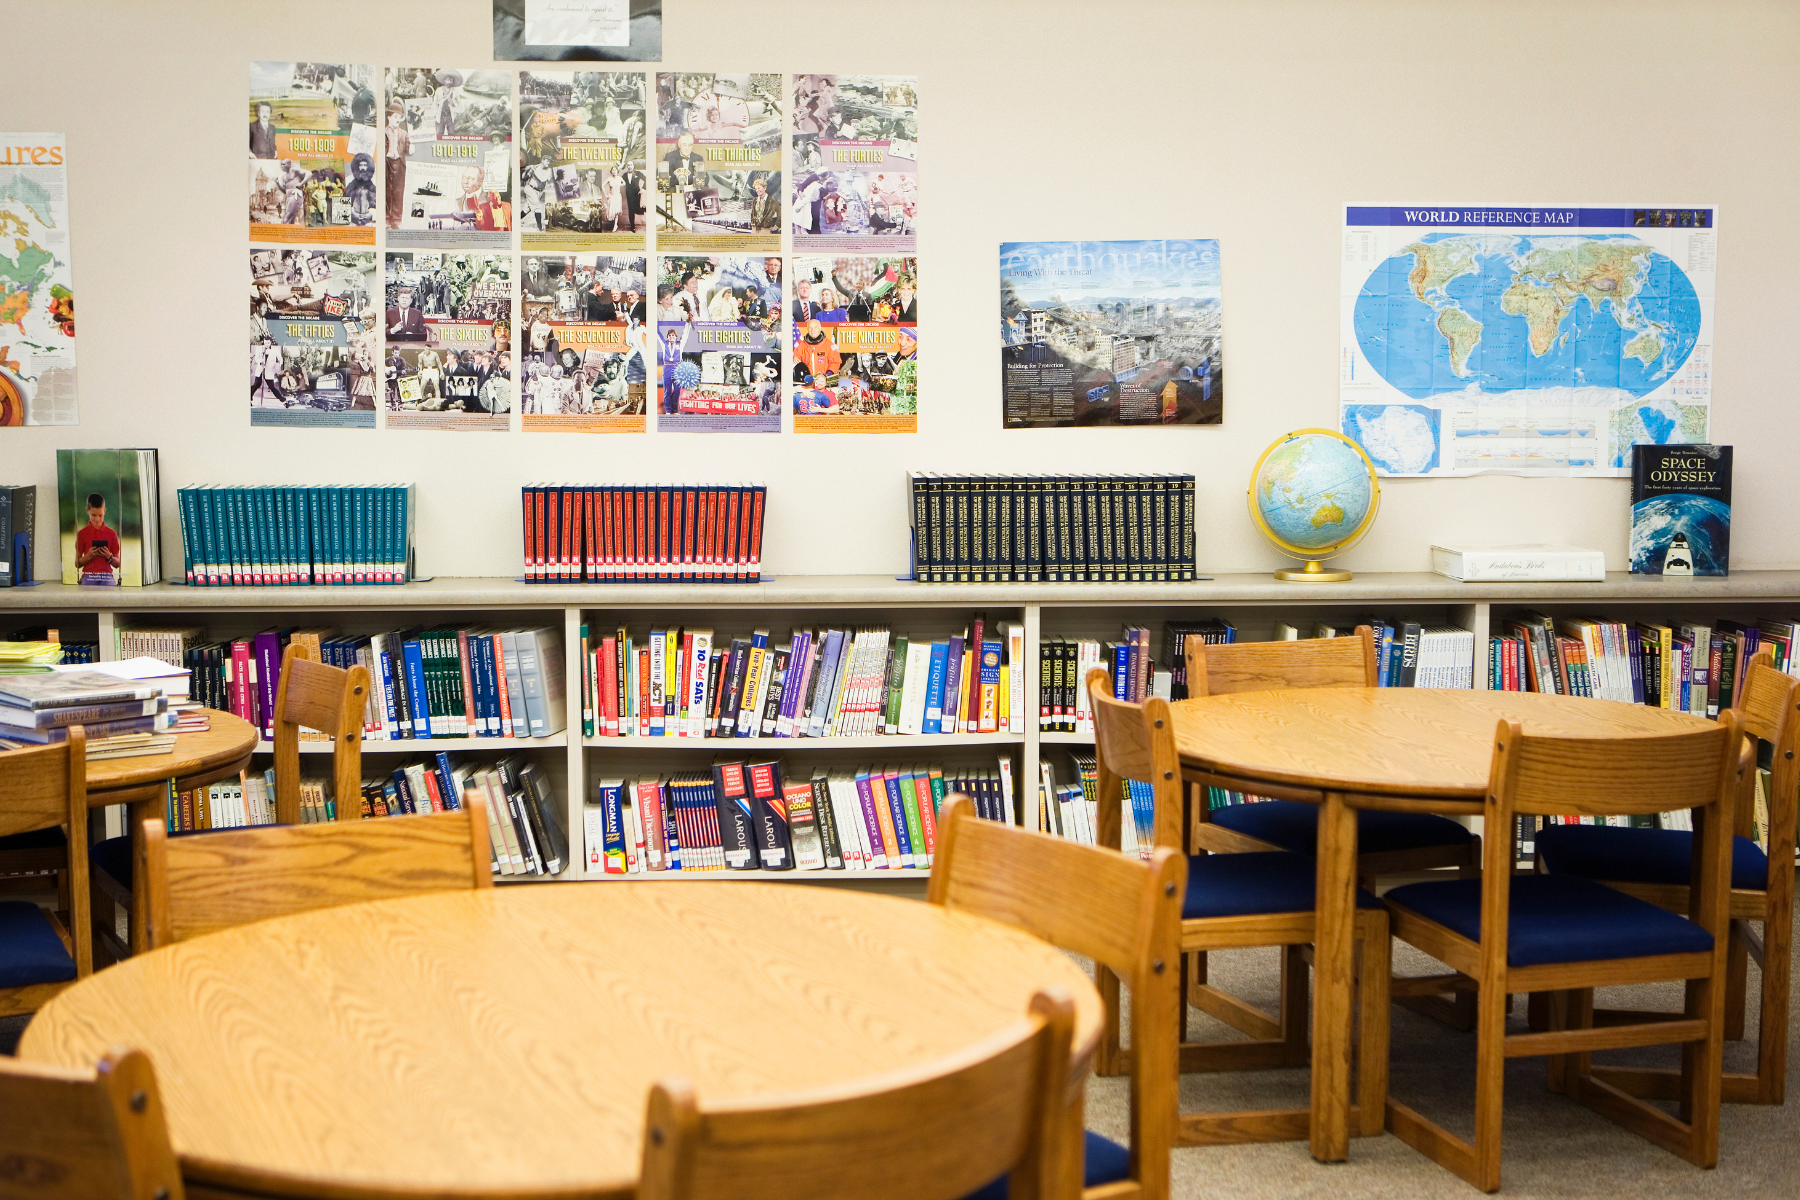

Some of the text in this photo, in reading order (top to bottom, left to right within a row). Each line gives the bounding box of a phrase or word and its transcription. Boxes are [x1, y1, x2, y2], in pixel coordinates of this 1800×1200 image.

[591, 4, 607, 14] repeat
[289, 138, 335, 152] 1900-1909
[431, 144, 478, 158] 1910-1919
[562, 147, 622, 160] THE TWENTIES
[708, 148, 760, 161] THE THIRTIES
[832, 149, 884, 163] THE FORTIES
[1404, 210, 1574, 224] WORLD REFERENCE MAP
[1006, 241, 1215, 274] earthquakes
[1009, 269, 1032, 278] Living
[475, 282, 512, 291] WE SHALL
[327, 305, 341, 314] IKE
[287, 324, 335, 338] THE FIFTIES
[440, 328, 488, 341] THE SIXTIES
[559, 330, 620, 343] THE SEVENTIES
[698, 330, 751, 343] THE EIGHTIES
[841, 330, 895, 344] THE NINETIES
[680, 401, 709, 409] FIGHTING
[738, 403, 756, 413] LIVES
[1661, 458, 1705, 469] SPACE
[1650, 471, 1716, 482] ODYSSEY
[1488, 560, 1545, 569] Audubon's Birds
[1403, 634, 1414, 668] BIRDS
[1712, 650, 1722, 682] Medicine
[694, 650, 706, 705] 10 Real SATs
[746, 651, 761, 707] Two-Year Colleges
[930, 660, 941, 706] ETIQUETTE
[1139, 653, 1147, 699] SKYWATCHING
[653, 681, 662, 704] ACT
[768, 685, 777, 701] BUYS
[54, 708, 100, 724] SHAKESPEARE
[399, 780, 410, 800] National
[786, 792, 811, 800] OCEANO
[608, 789, 617, 832] LONGMAN
[863, 790, 871, 815] POPULAR
[868, 815, 877, 836] SCIENCE
[877, 790, 885, 814] POPULAR
[881, 814, 891, 836] SCIENCE
[891, 789, 900, 813] POPULAR
[896, 813, 904, 835] SCIENCE
[643, 796, 654, 852] Visual Dictionar
[814, 783, 823, 808] SCIENCE
[822, 826, 831, 858] REFERENC
[910, 814, 918, 836] SCIENCE
[734, 814, 747, 851] LAROUS
[764, 816, 776, 849] LAROU
